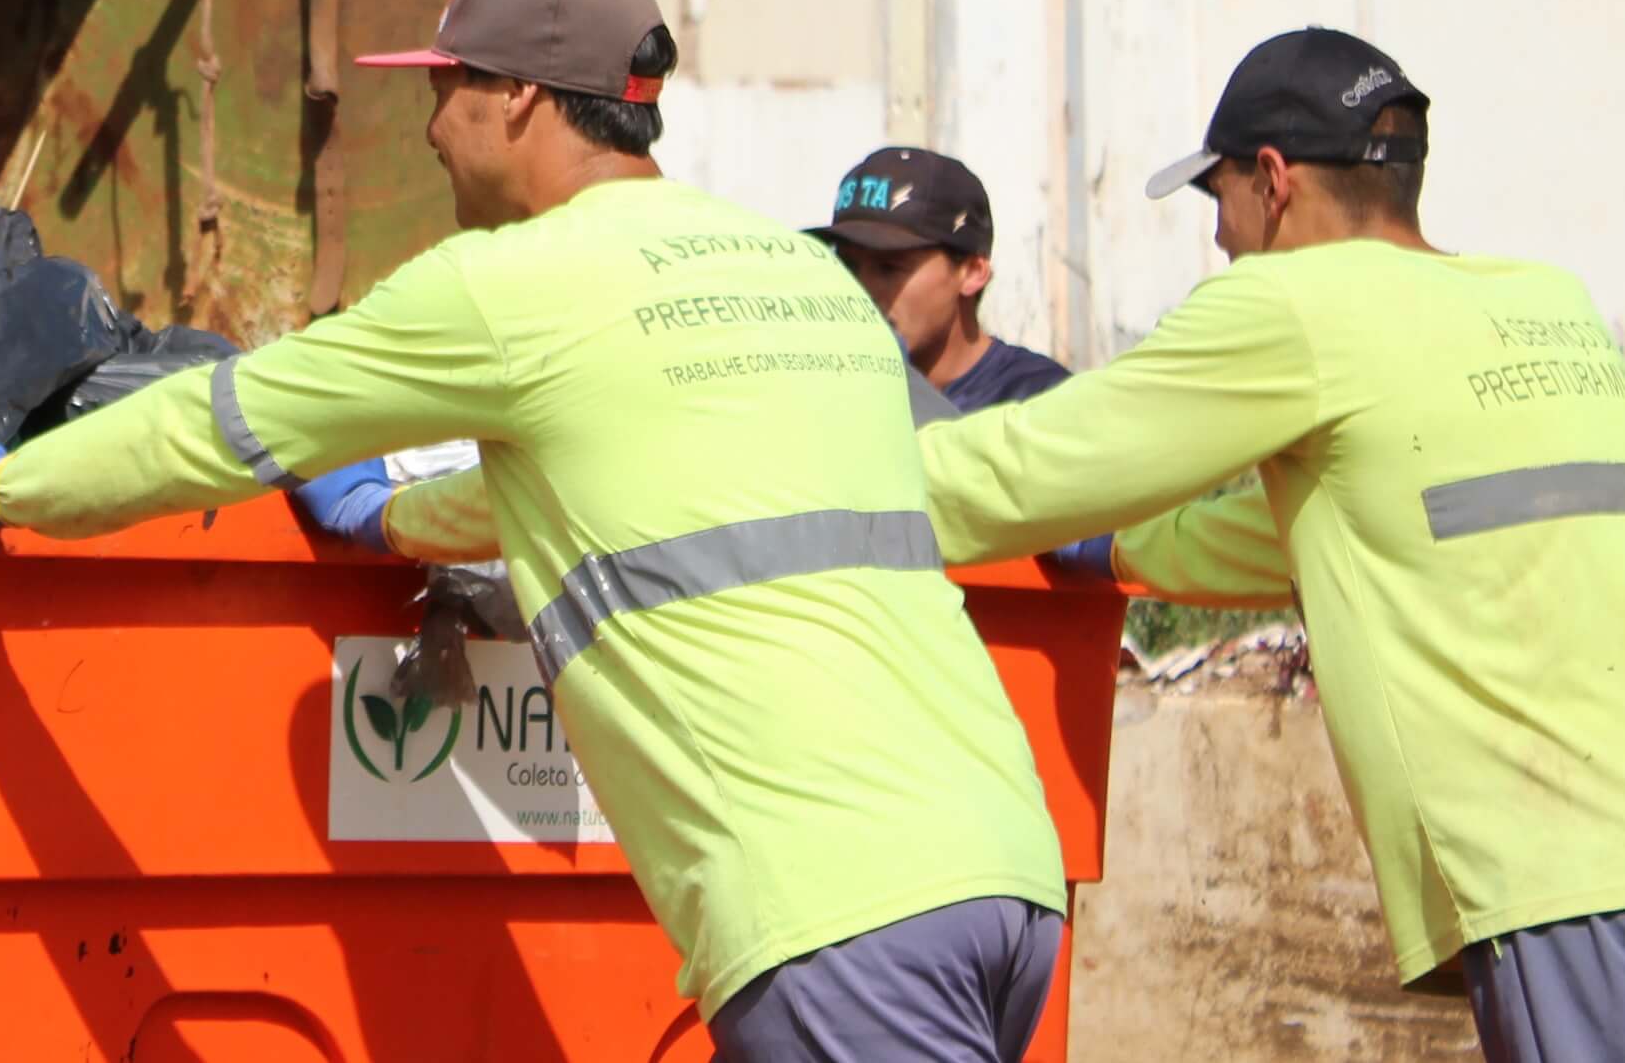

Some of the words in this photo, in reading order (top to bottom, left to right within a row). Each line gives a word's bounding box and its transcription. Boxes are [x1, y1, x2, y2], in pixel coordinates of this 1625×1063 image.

[634, 294, 796, 336] PREFEITURA
[662, 355, 745, 388] TRABALHE
[747, 352, 778, 374] COM
[1467, 360, 1608, 411] PREFEITURA
[477, 685, 571, 753] NA
[507, 762, 569, 787] Coleta
